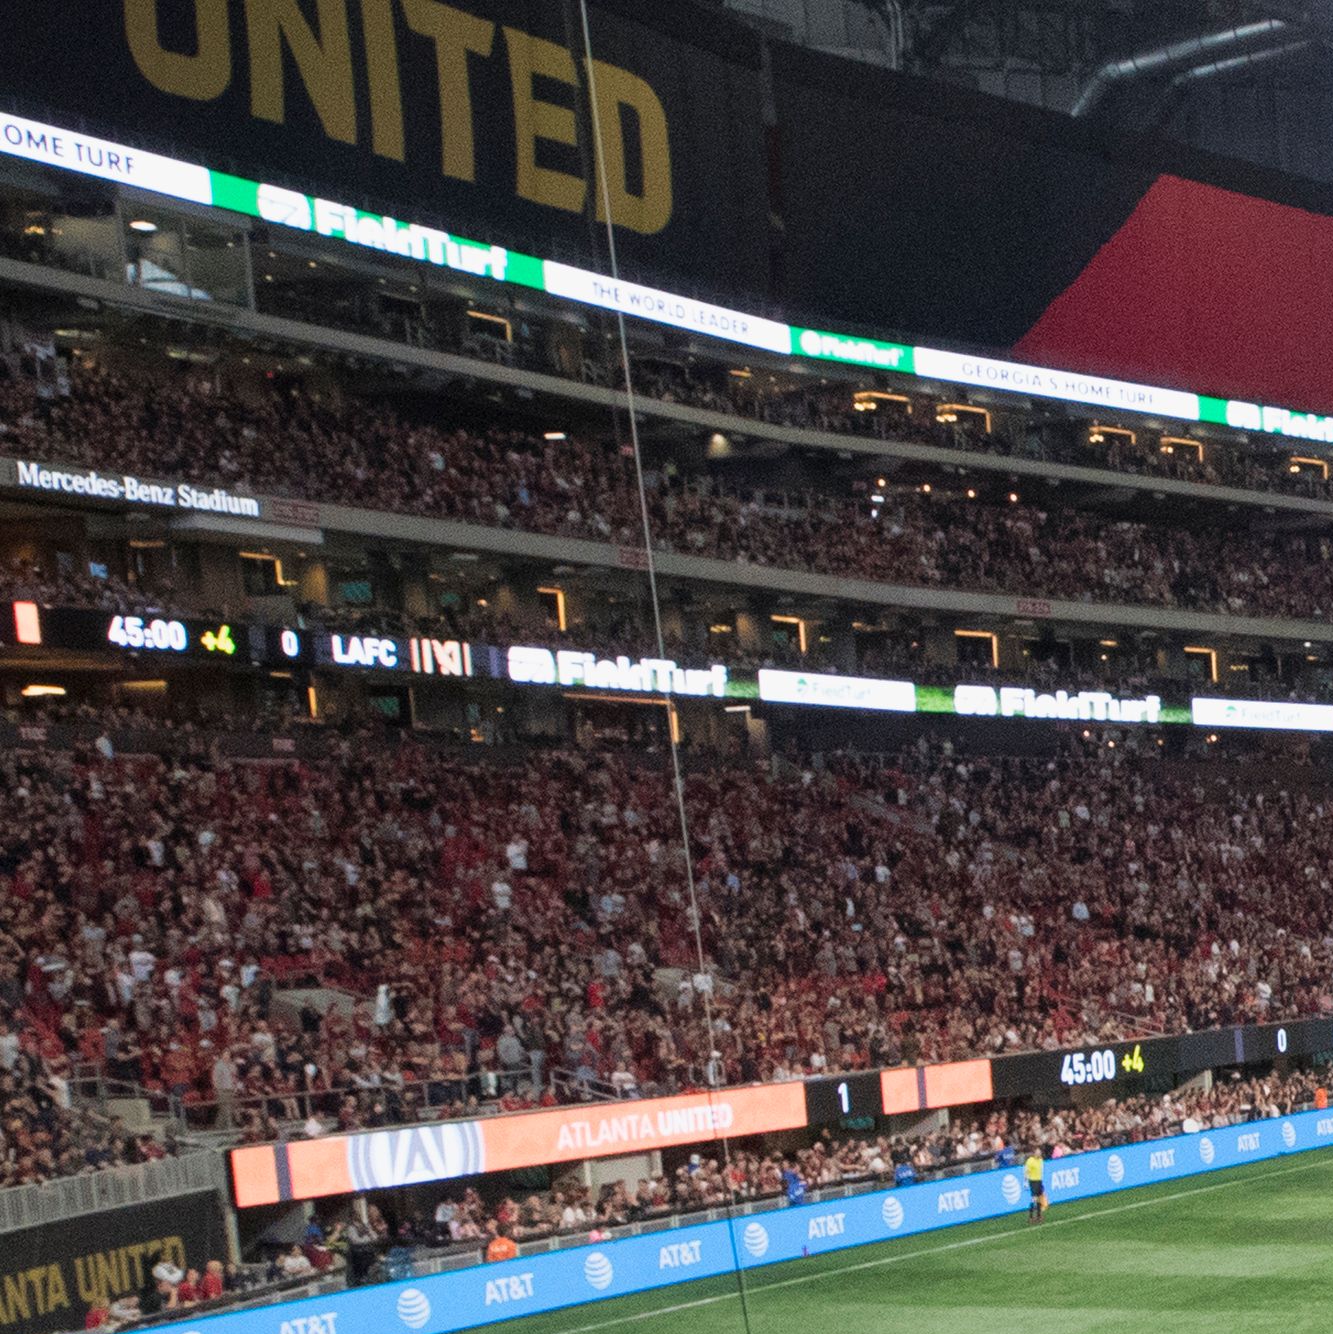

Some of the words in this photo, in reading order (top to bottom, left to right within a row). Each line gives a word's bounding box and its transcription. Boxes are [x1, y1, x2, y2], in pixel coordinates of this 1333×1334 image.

[123, 0, 674, 236] UNITED
[75, 142, 135, 174] TURF
[629, 291, 686, 320] WORLD
[961, 362, 1058, 389] GEORGIAS
[17, 460, 176, 507] Mercedes-Benz
[177, 484, 260, 518] Stadium
[107, 615, 189, 652] 45:00
[200, 624, 236, 656] +4
[331, 634, 398, 668] LAFC
[1276, 1028, 1287, 1053] 0
[1060, 1049, 1116, 1085] 45:00
[1121, 1044, 1145, 1073] +4
[836, 1082, 850, 1114] 1
[557, 1114, 651, 1150] ATLANTA
[657, 1103, 733, 1136] UNITED
[1150, 1148, 1176, 1170] AT&T
[1051, 1167, 1080, 1191] AT&T
[938, 1188, 971, 1215] AT&T
[808, 1213, 846, 1240] AT&T
[659, 1240, 702, 1269] AT&T
[485, 1273, 535, 1306] AT&T
